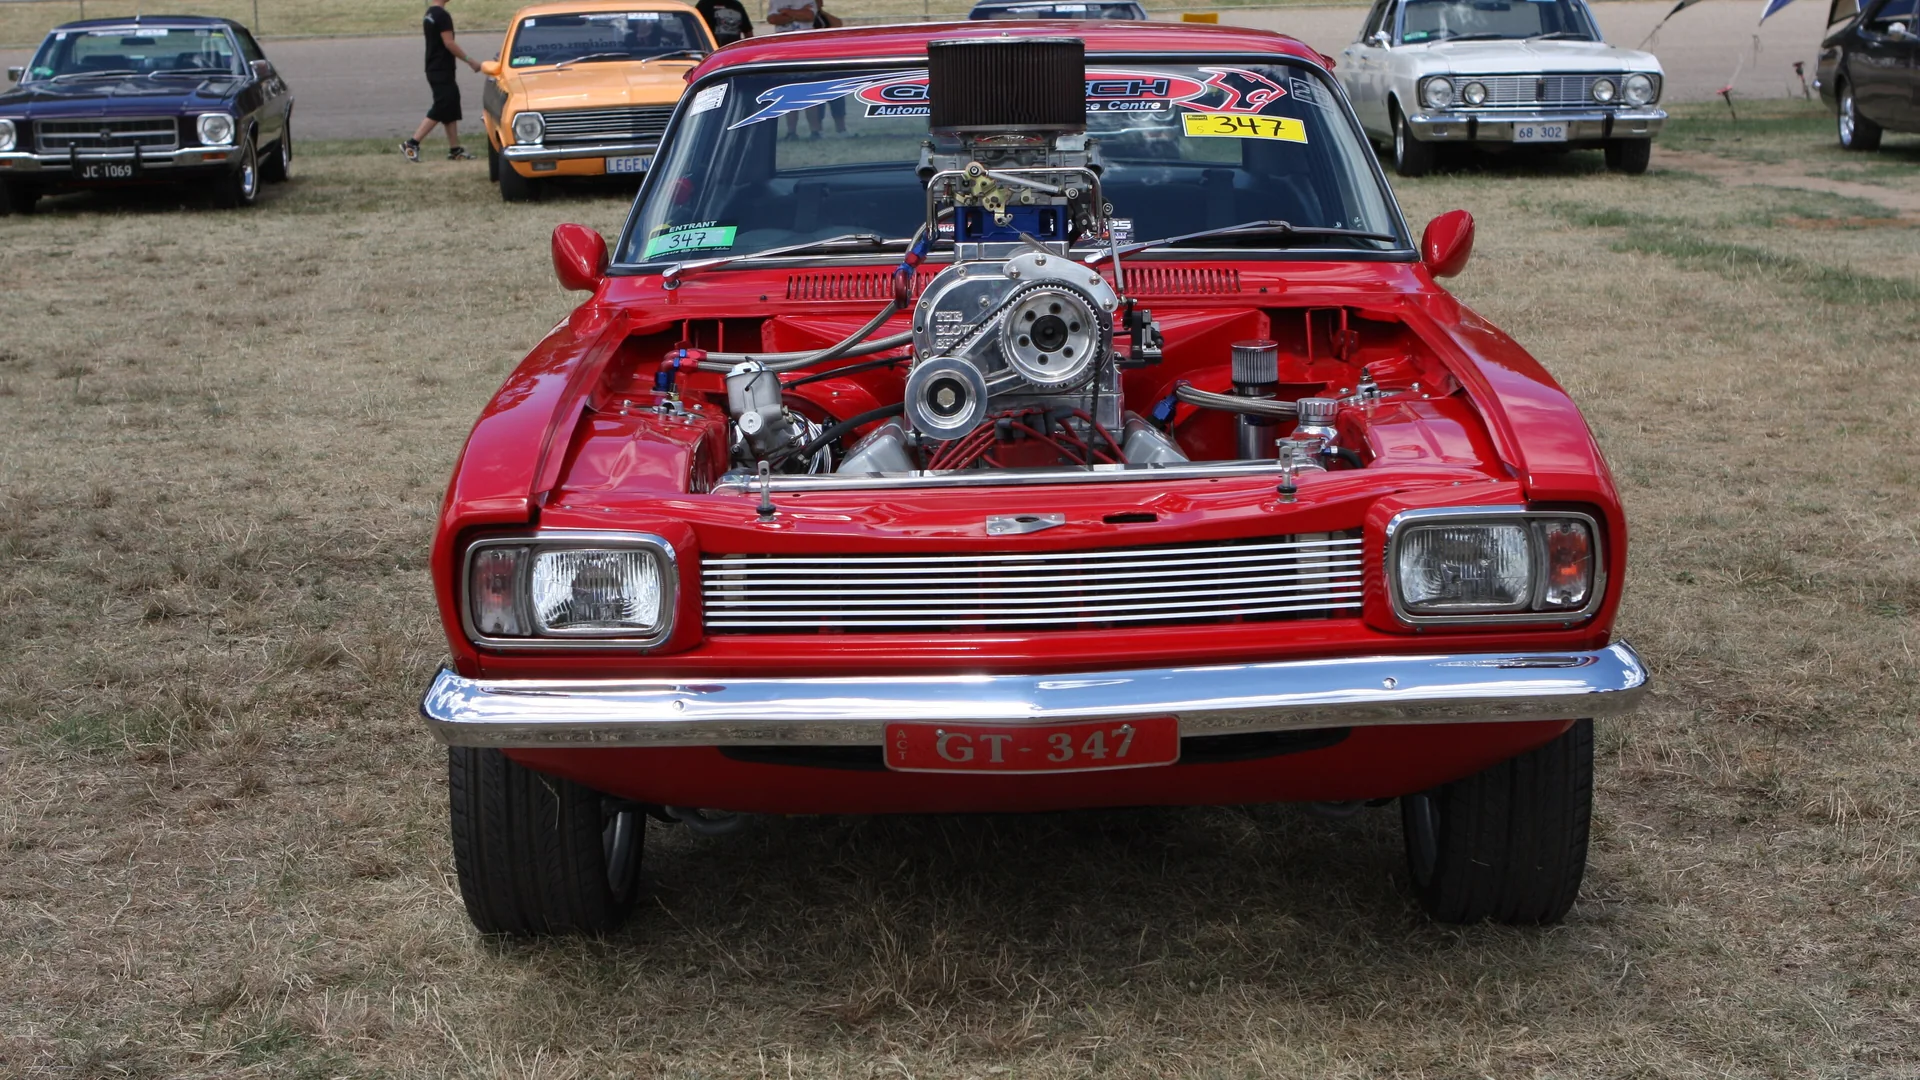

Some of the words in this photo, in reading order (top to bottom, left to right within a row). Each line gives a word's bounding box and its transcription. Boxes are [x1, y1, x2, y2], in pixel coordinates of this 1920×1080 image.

[874, 104, 930, 115] Autom
[1107, 100, 1161, 110] Centre
[1214, 115, 1286, 137] 347
[1518, 126, 1533, 139] 68
[1540, 126, 1562, 138] 302
[82, 165, 99, 178] JC
[104, 164, 132, 177] 1069
[607, 157, 653, 172] LEGEN
[669, 221, 717, 233] ENTRANT
[669, 232, 707, 249] 347
[935, 311, 963, 322] THE
[1047, 727, 1137, 763] 347
